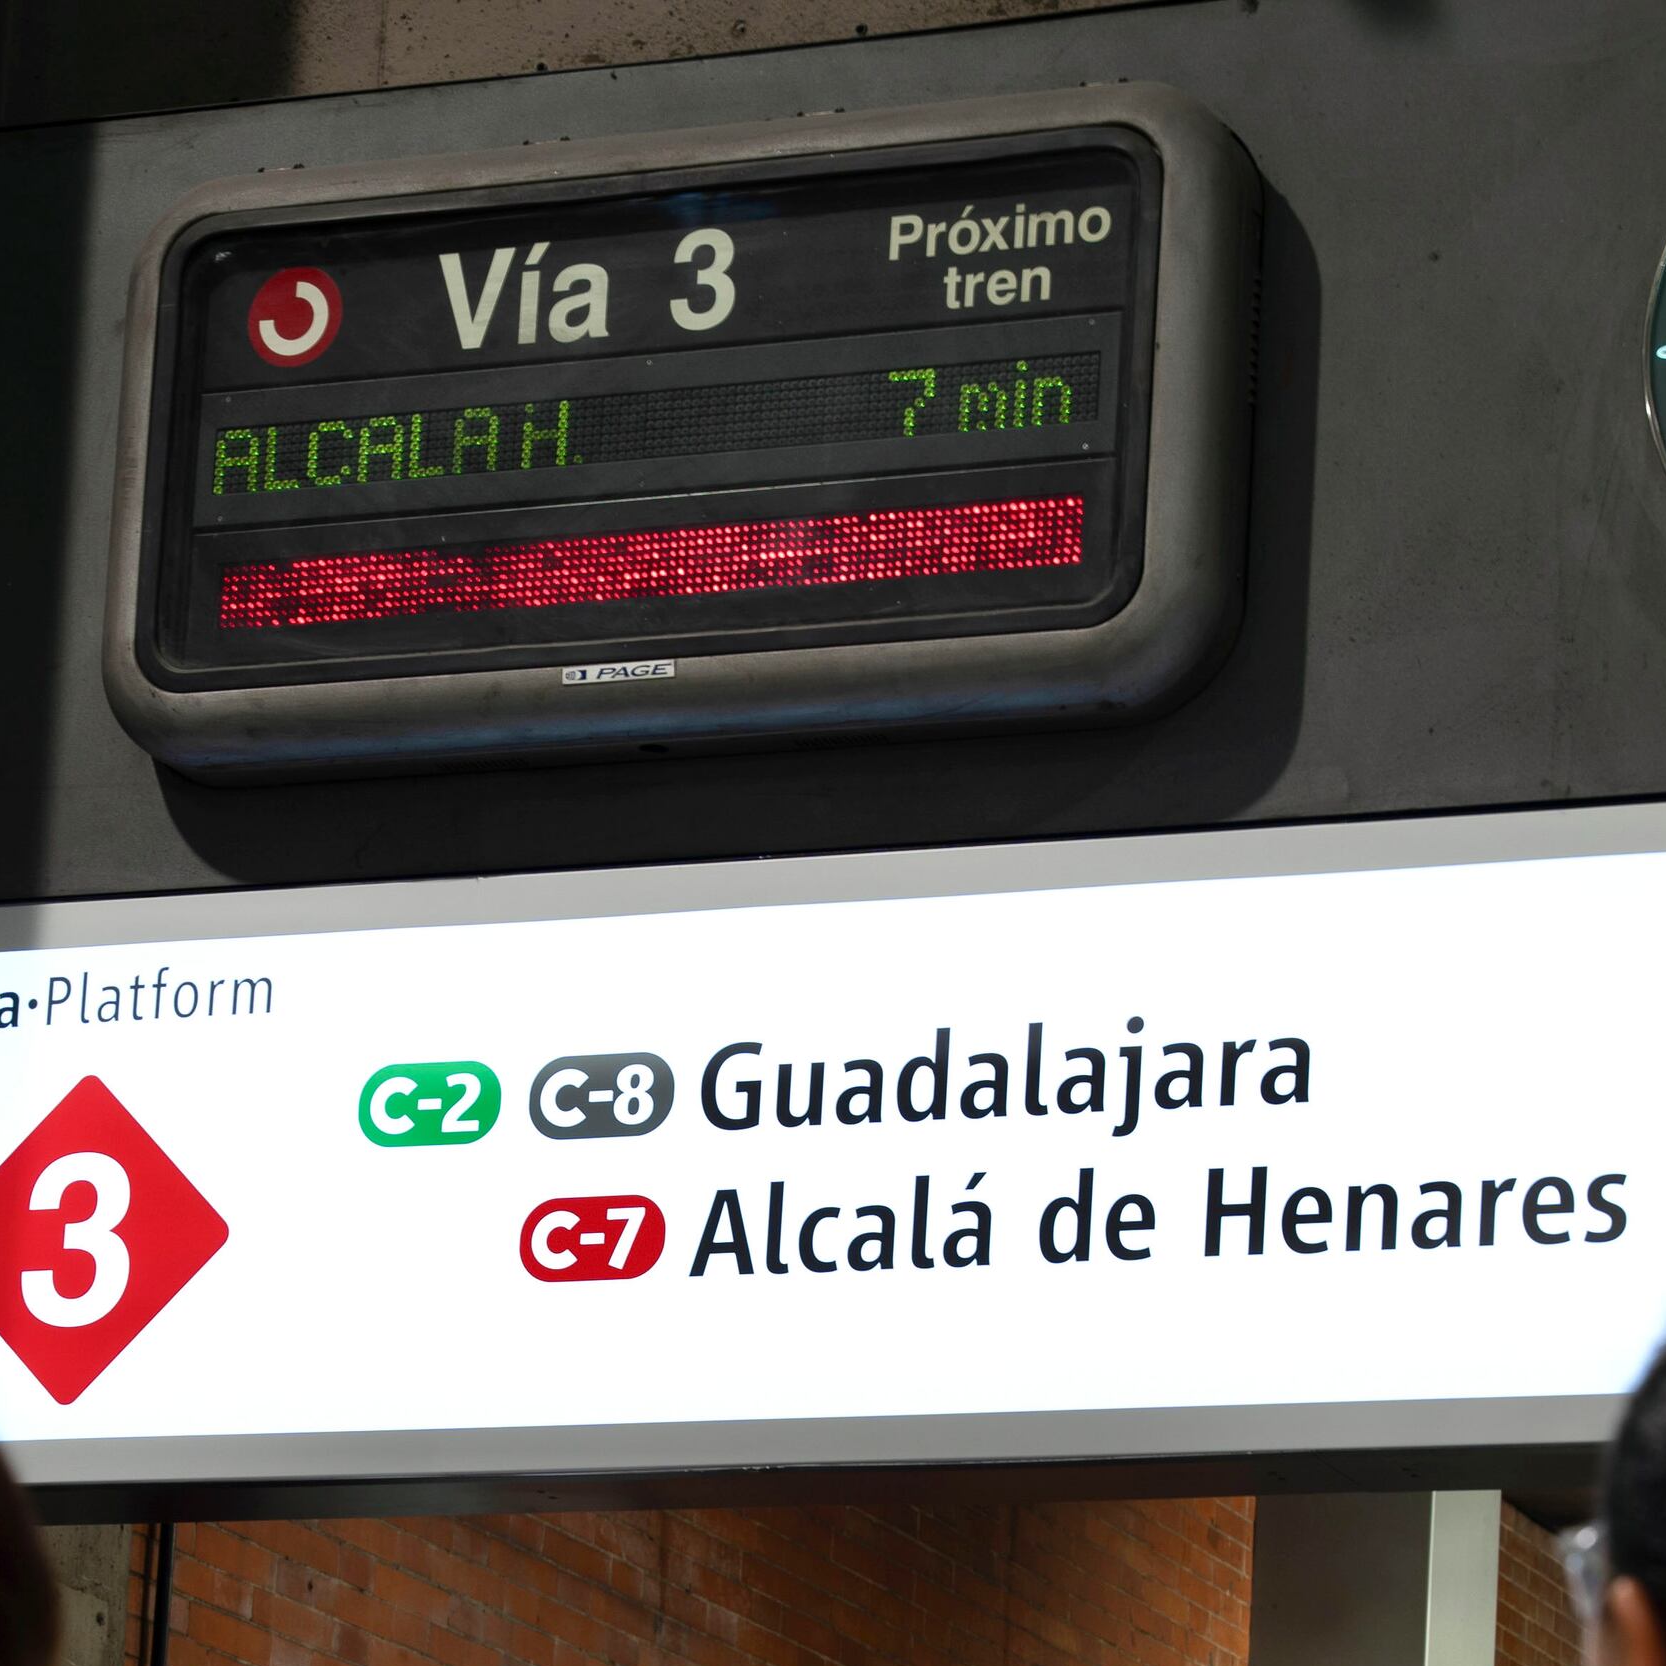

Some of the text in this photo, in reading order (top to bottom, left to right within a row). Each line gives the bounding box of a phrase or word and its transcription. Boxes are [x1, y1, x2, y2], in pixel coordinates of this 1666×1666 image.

[439, 228, 735, 349] Vía 3
[889, 204, 1111, 263] Próximo
[943, 261, 1051, 310] tren
[213, 407, 499, 495] ALCALA
[889, 368, 935, 437] 7
[957, 358, 1072, 435] min
[596, 663, 672, 679] PAGE
[369, 1016, 1313, 1138] C-2 C-8 Guadalajara
[20, 1151, 132, 1329] 3
[531, 1165, 1628, 1279] C-7 Alcalá de Henares
